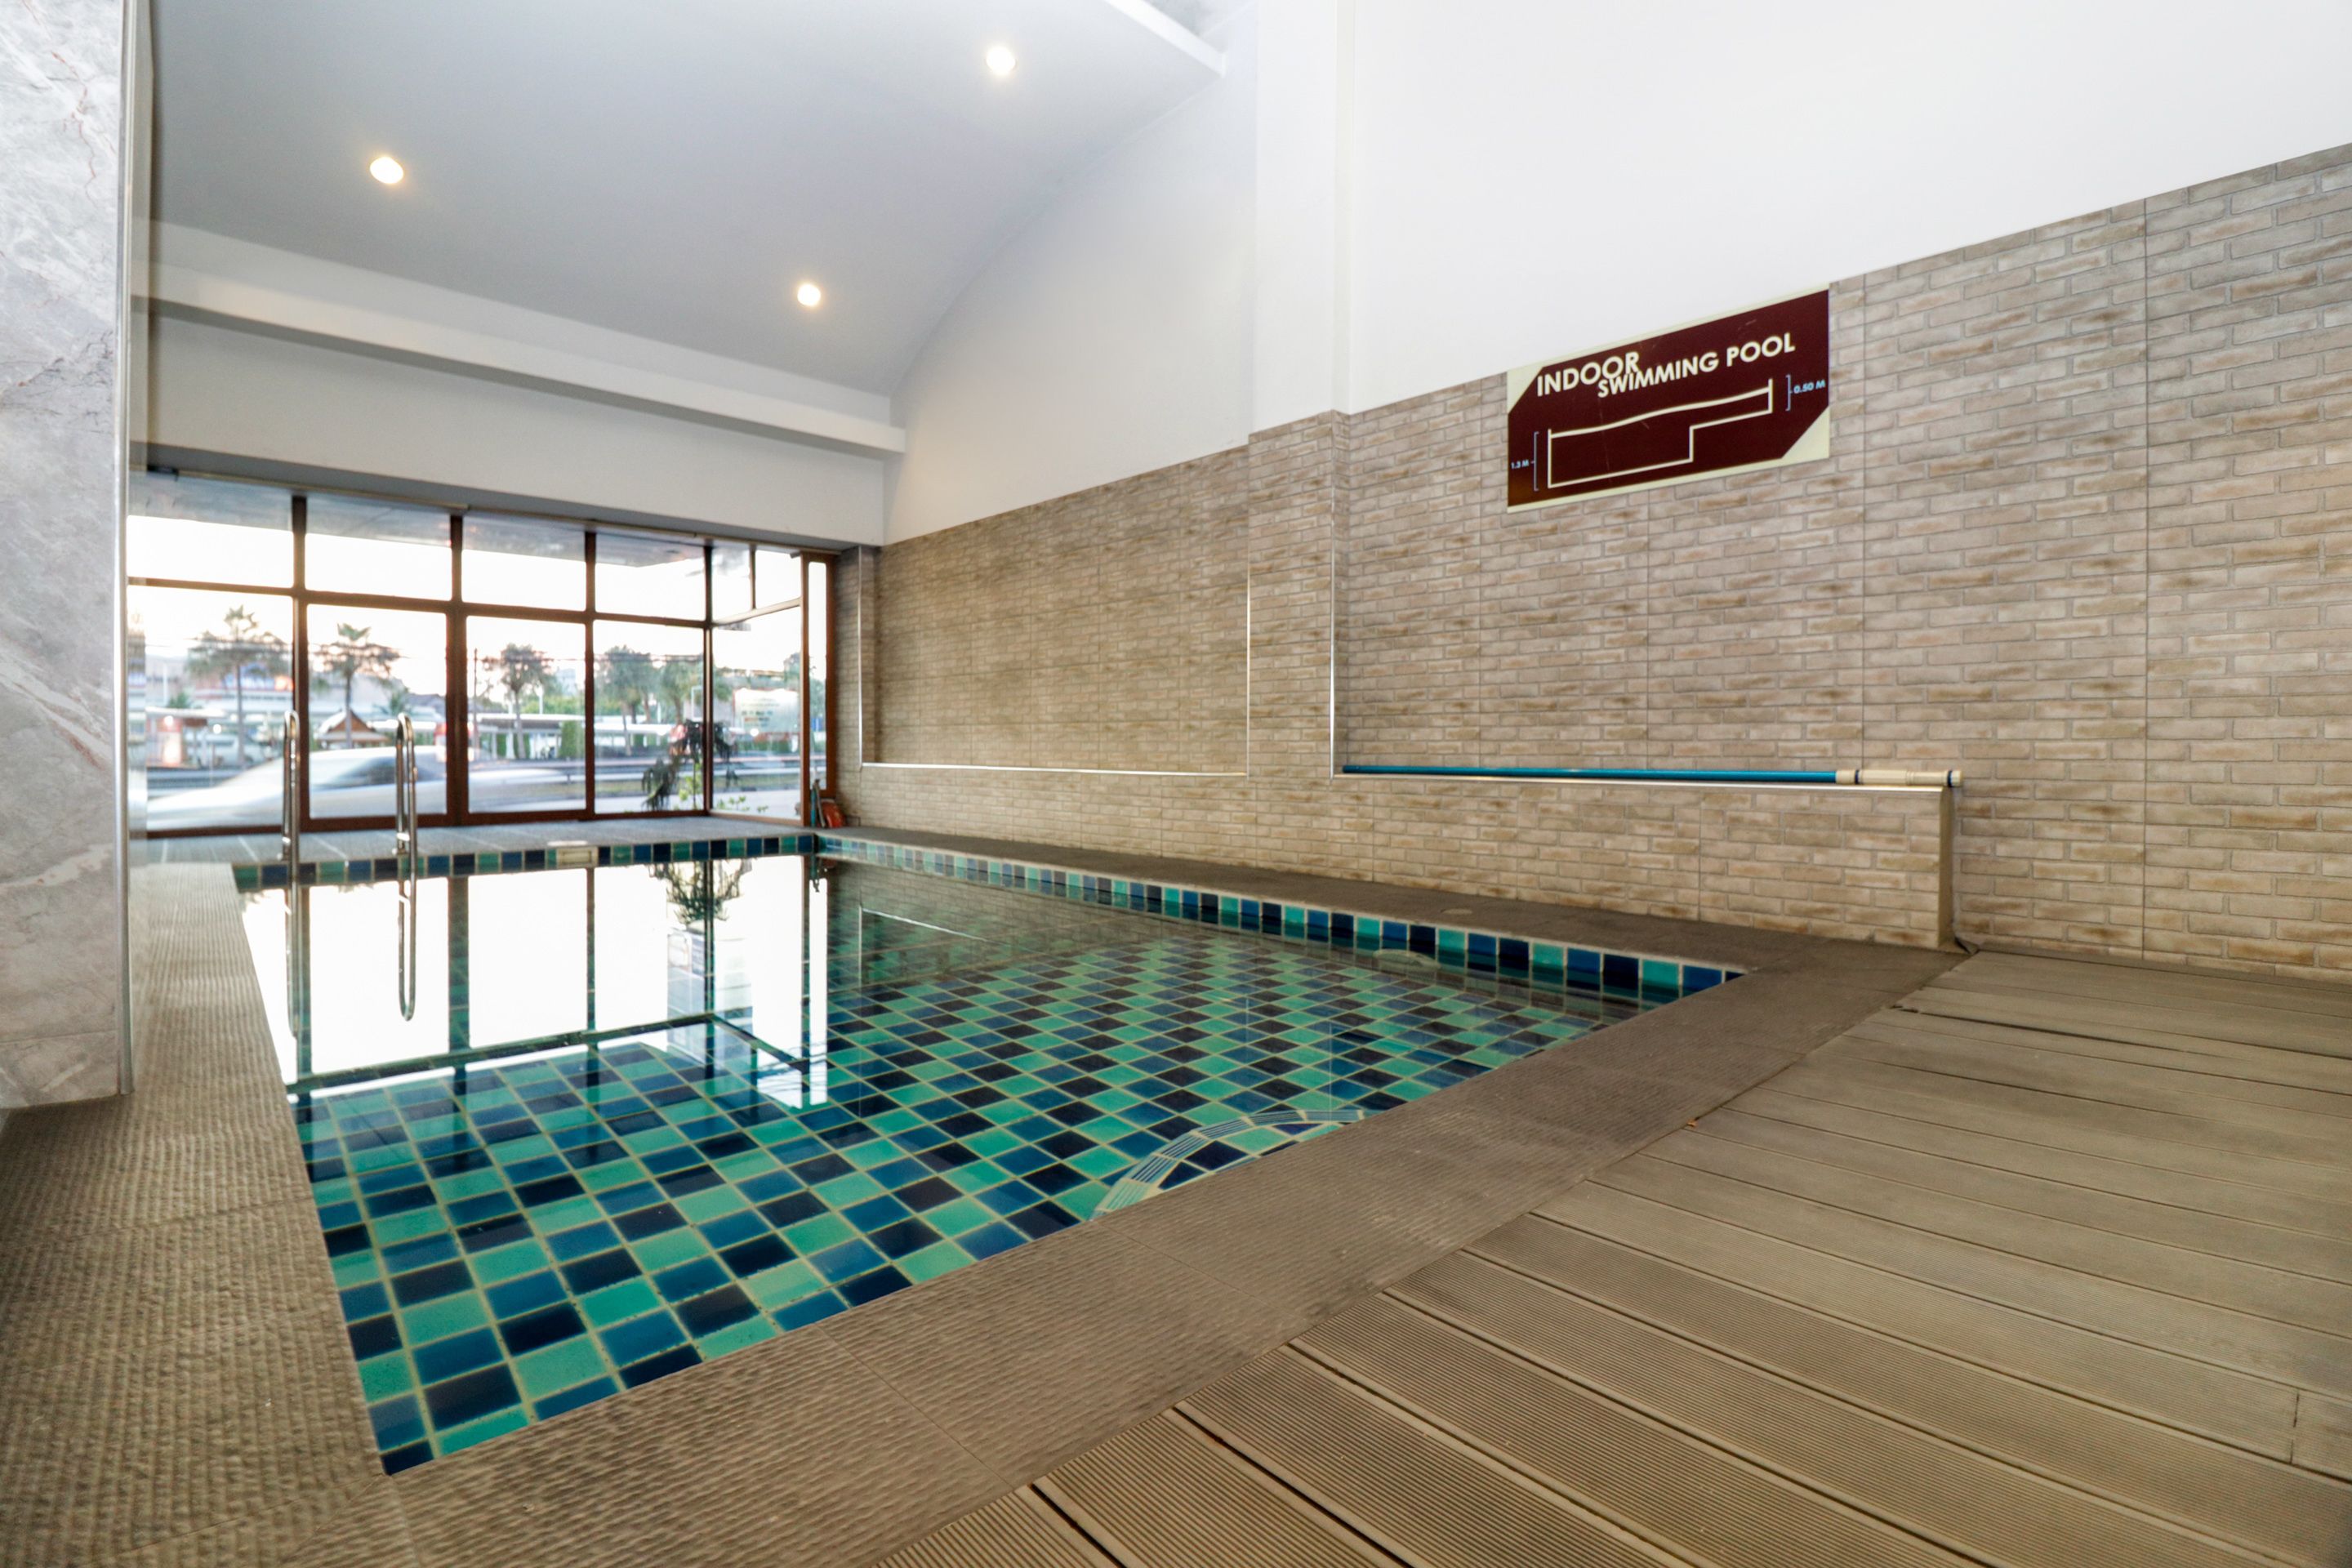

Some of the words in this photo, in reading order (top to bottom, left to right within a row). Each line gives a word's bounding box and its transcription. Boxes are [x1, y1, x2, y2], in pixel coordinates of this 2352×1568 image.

[1537, 351, 1640, 397] INDOOR
[1597, 351, 1719, 399] SWIMMING
[1726, 332, 1796, 367] POOL
[1815, 379, 1825, 390] M
[1521, 459, 1530, 468] M
